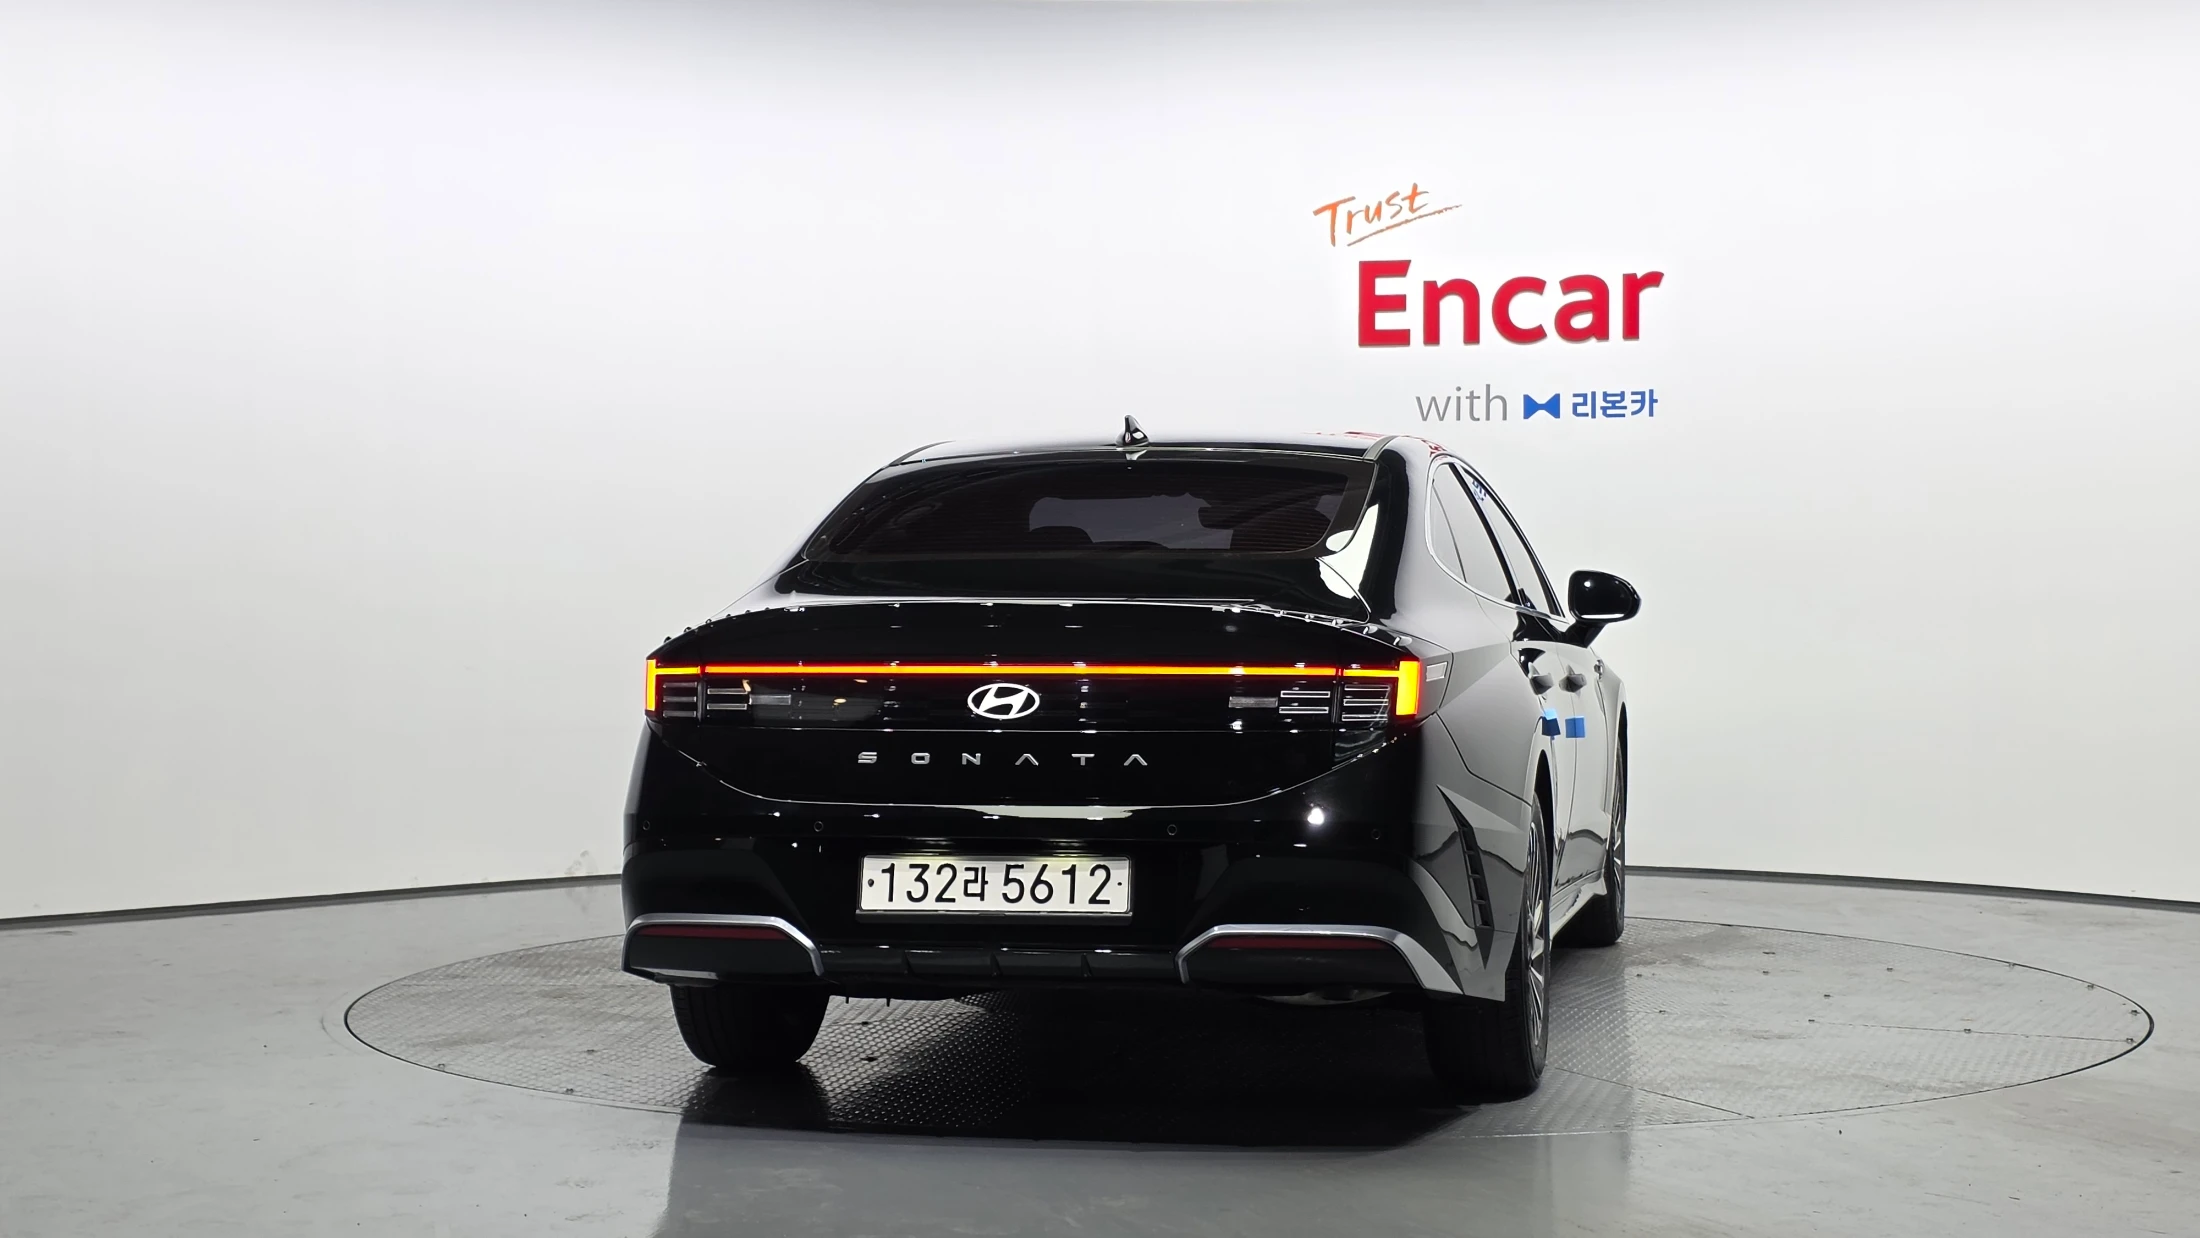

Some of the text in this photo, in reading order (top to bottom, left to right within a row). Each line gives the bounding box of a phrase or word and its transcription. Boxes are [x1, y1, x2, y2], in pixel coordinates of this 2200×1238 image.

[1313, 182, 1430, 247] Trust
[1357, 259, 1665, 347] Encar
[1415, 384, 1659, 422] with 리본카
[857, 751, 1148, 767] SONATA
[881, 862, 1112, 905] 132라 5612
